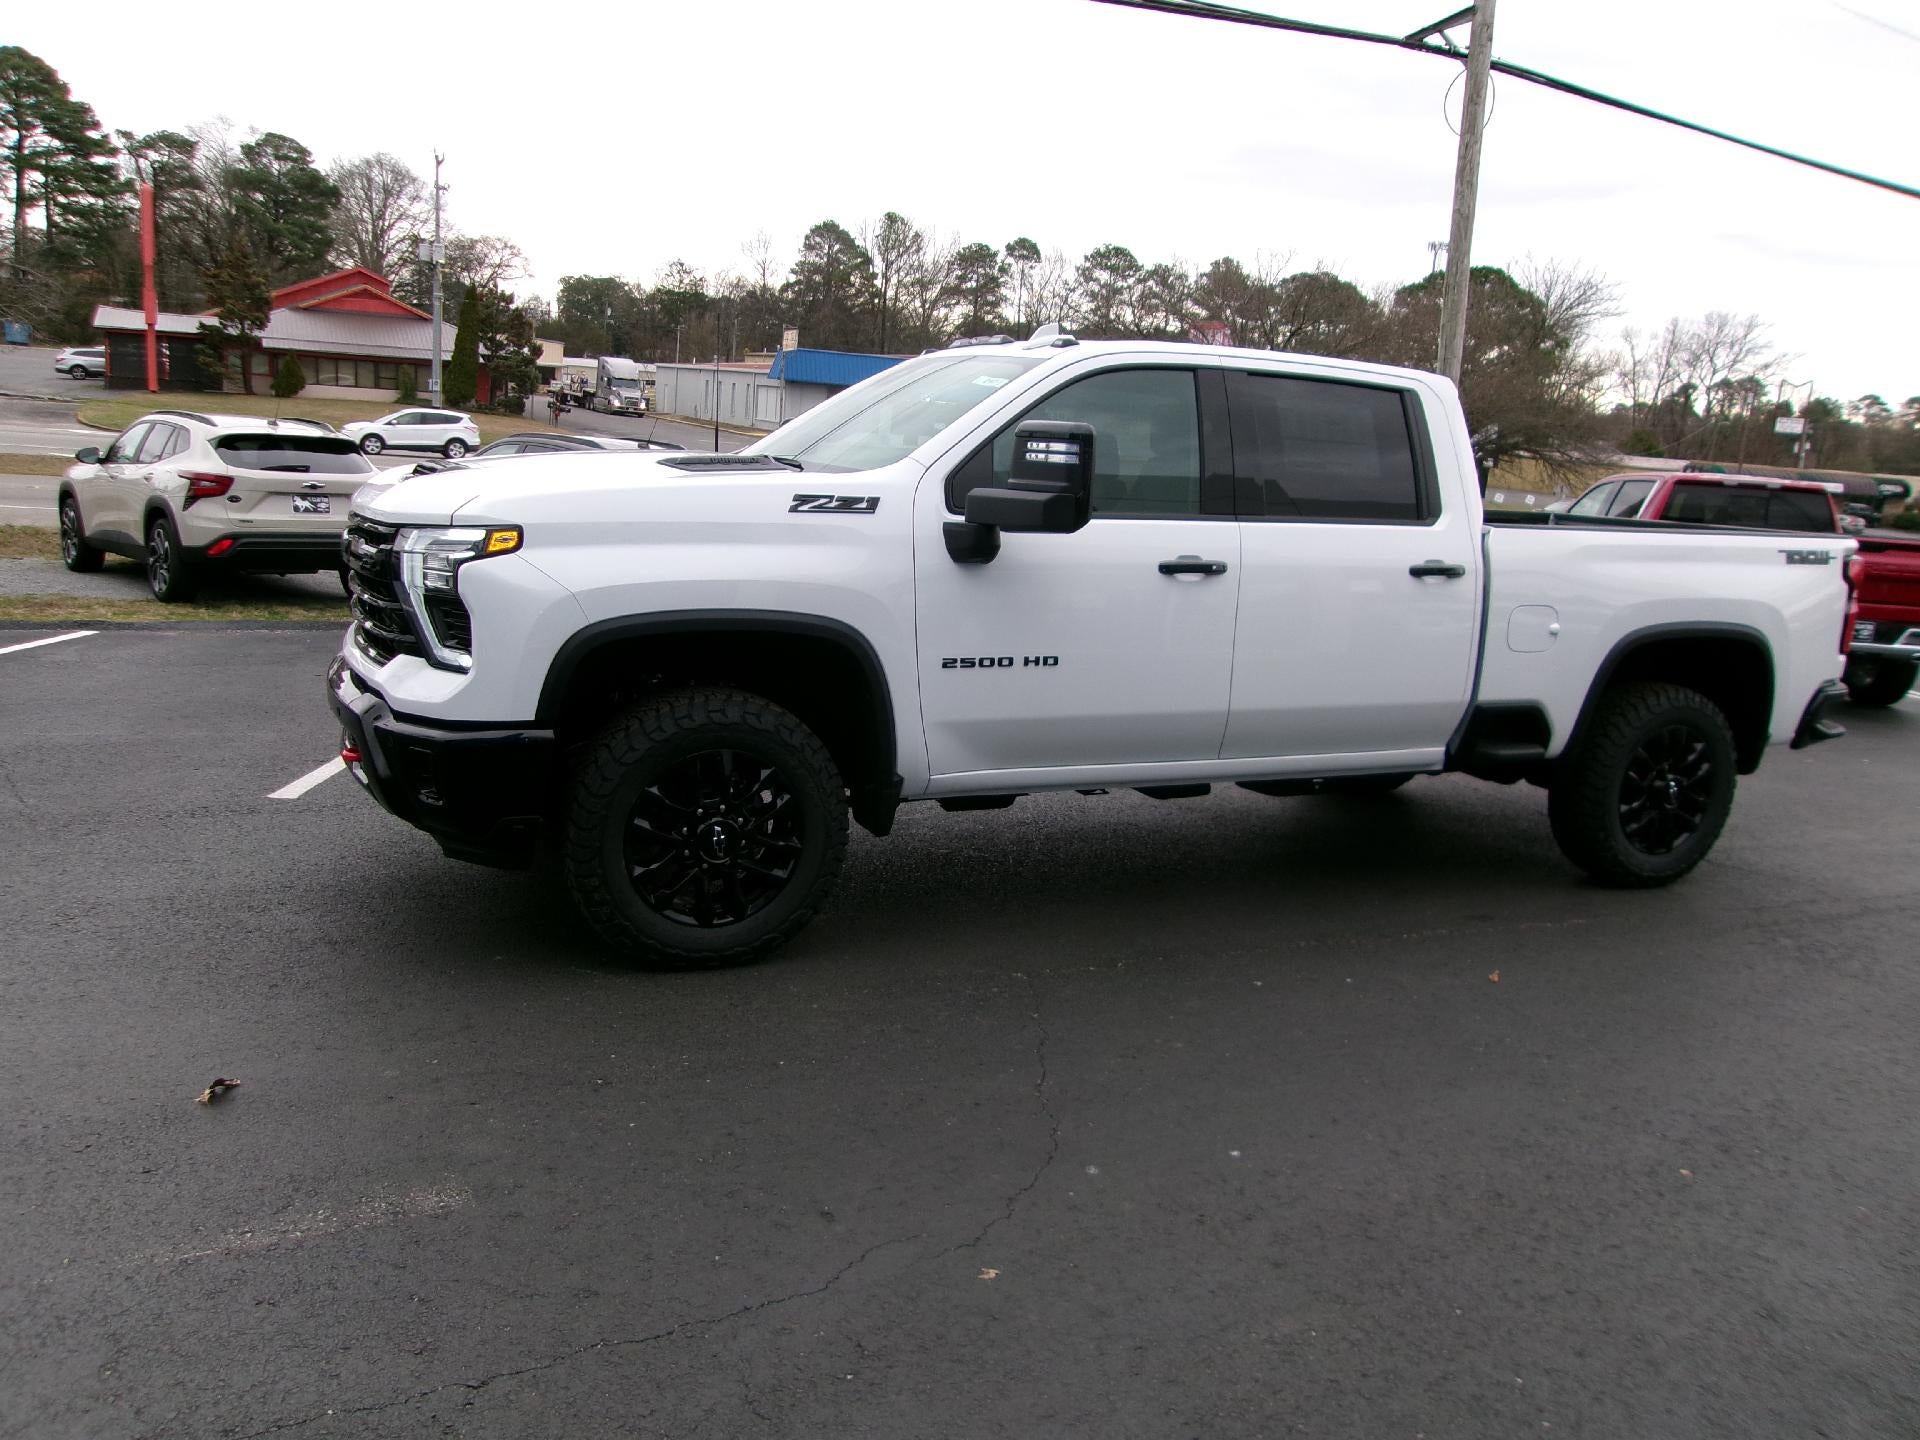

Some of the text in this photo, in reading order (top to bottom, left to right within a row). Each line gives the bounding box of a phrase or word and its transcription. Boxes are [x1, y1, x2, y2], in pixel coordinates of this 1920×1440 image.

[788, 494, 881, 514] Z71
[941, 656, 1059, 669] 2500 HD
